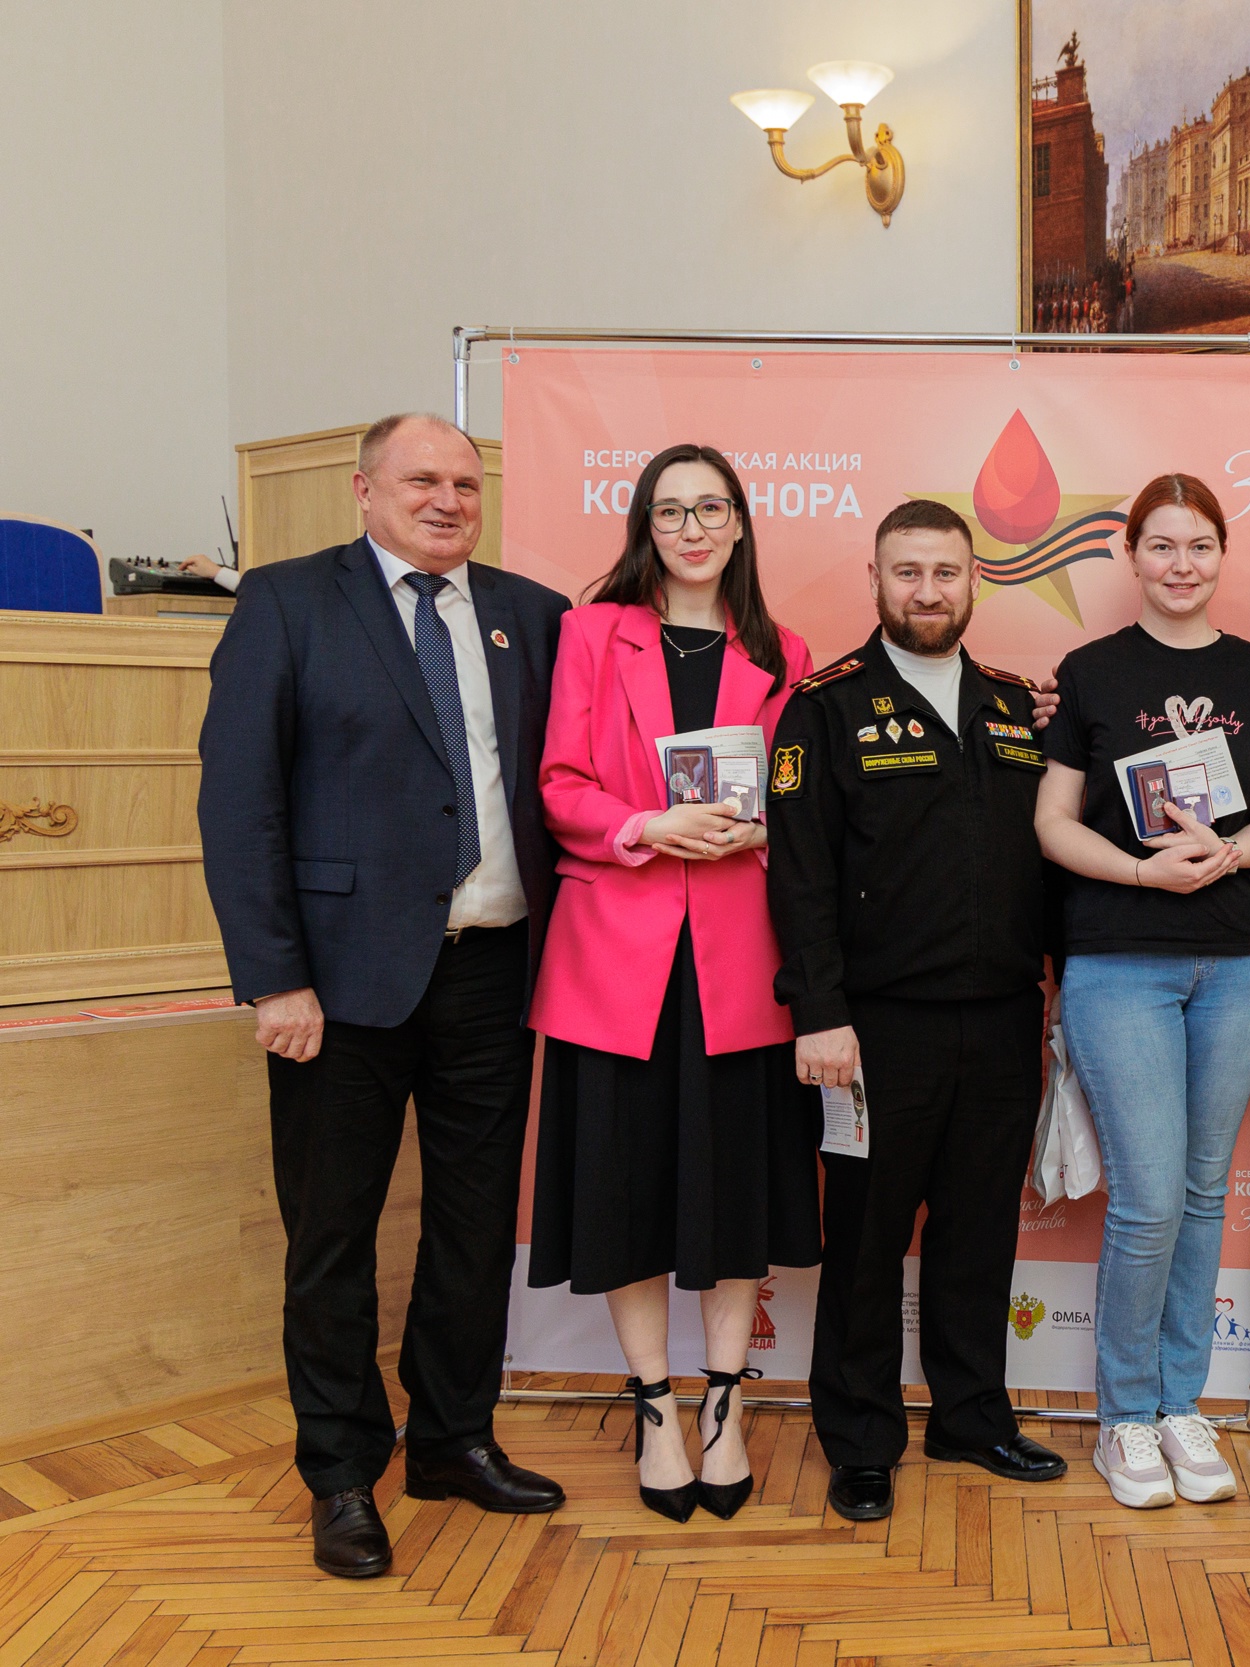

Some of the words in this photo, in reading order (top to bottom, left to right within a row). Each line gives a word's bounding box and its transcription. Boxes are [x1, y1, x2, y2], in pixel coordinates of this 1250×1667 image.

[583, 450, 777, 470] ВСЕРОСКАЯ
[782, 452, 861, 473] АКЦИЯ
[583, 479, 634, 515] КО
[749, 482, 863, 518] НОРА
[1052, 1311, 1092, 1324] ФМБА
[749, 1338, 776, 1351] БЕДА!
